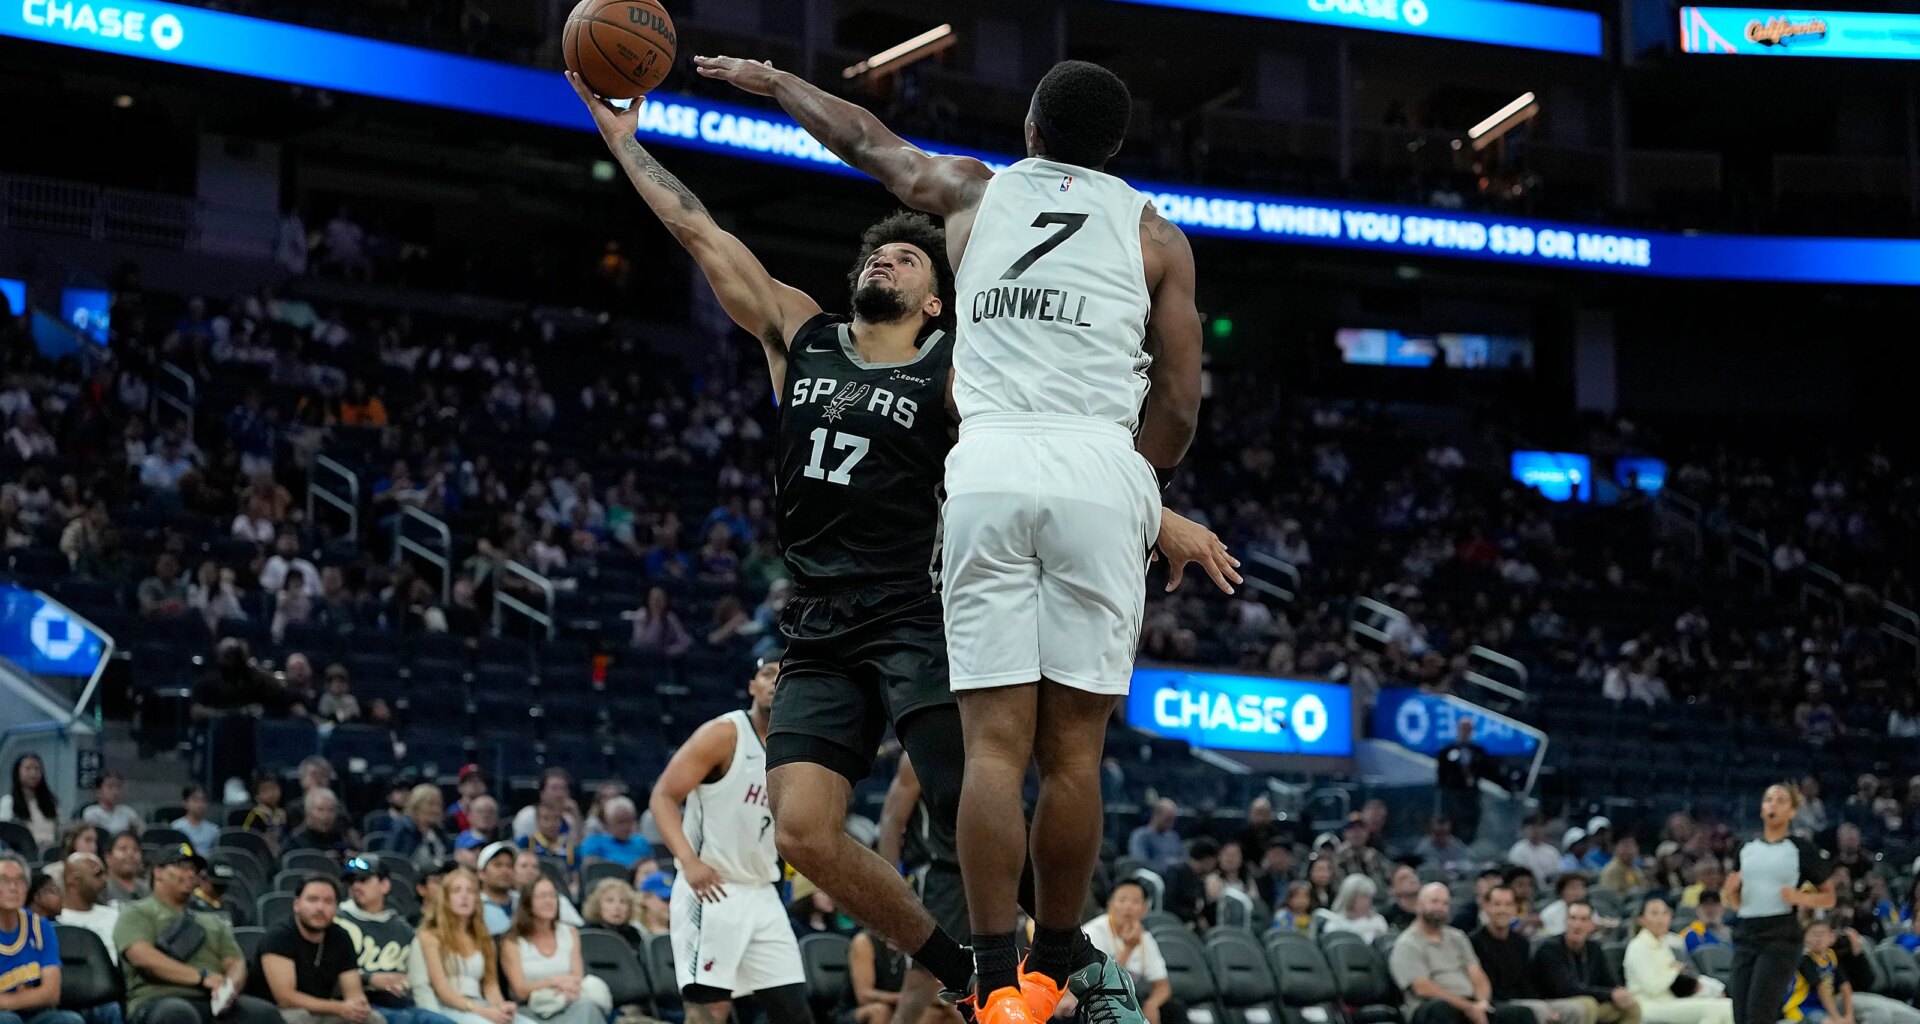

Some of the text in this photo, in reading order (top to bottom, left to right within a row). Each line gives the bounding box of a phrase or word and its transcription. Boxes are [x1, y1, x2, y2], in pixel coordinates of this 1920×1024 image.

[22, 0, 146, 42] CHASE
[999, 212, 1089, 280] 7
[1141, 191, 1256, 231] CHASES
[1256, 202, 1342, 238] WHEN
[1342, 210, 1401, 243] YOU
[1401, 215, 1488, 251] SPEND
[1536, 228, 1577, 260] OR
[1577, 232, 1651, 267] MORE
[972, 286, 1092, 328] CONWELL
[803, 427, 870, 486] 17
[1154, 688, 1287, 733] CHASE
